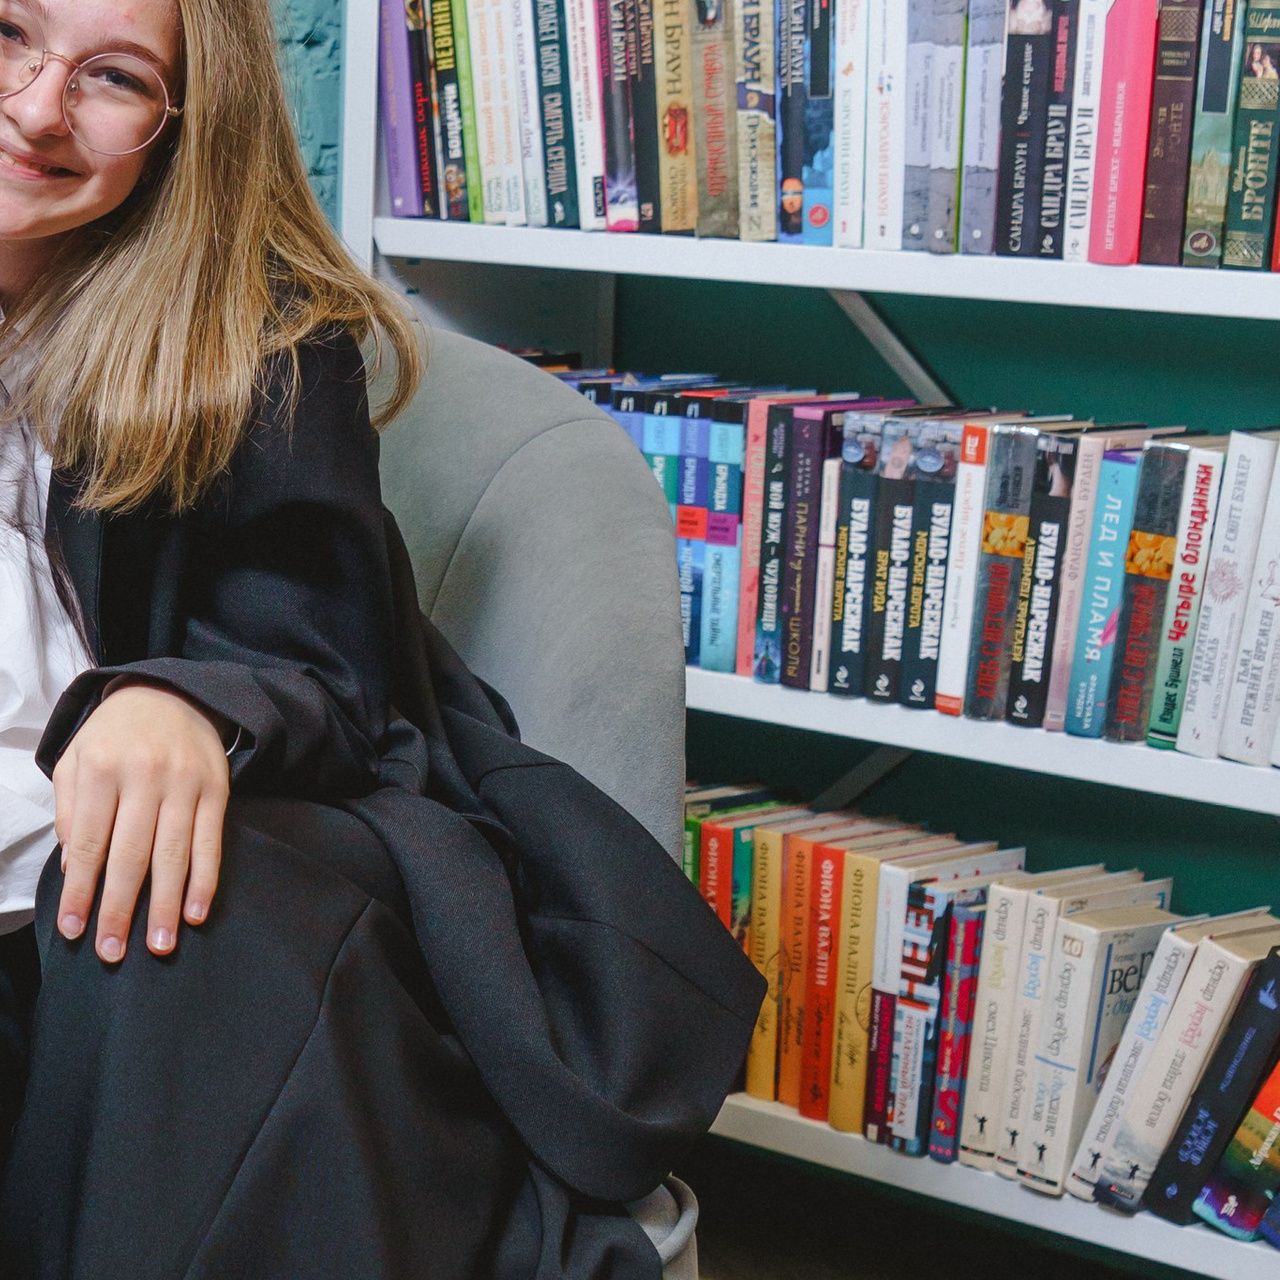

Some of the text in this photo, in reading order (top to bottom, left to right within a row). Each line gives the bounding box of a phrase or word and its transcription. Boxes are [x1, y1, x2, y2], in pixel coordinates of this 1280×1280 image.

[539, 43, 561, 87] БОУЭН
[611, 30, 628, 81] БРАУН
[638, 18, 654, 65] БРАУН
[664, 24, 684, 96] БРАУН
[742, 13, 763, 85] БРАУН
[791, 33, 806, 83] БРАУН
[443, 83, 463, 159] БОЛДАЧЧИ
[542, 92, 564, 146] СМЕРТЬ
[1043, 103, 1069, 160] БРАУН
[546, 146, 567, 196] СЕРДЦА
[1011, 142, 1028, 252] САНДРА БРАУН
[1039, 162, 1065, 228] САНДРА
[1070, 107, 1095, 230] САНДРА БРАУН
[1240, 120, 1274, 221] БРОНТЕ
[682, 457, 697, 505] БРЫНДЗА
[712, 464, 729, 511] БРЫНДЗА
[767, 480, 784, 509] МОЙ
[1073, 453, 1095, 502] БУРДЕН
[765, 512, 782, 544] МУЖ
[1066, 509, 1089, 582] ФРАНСУАЗА
[1181, 463, 1214, 565] блондинки
[760, 558, 779, 632] ЧУДОВИЩЕ
[786, 501, 810, 678] ПАРНИ ШКОЛЫ
[832, 525, 849, 621] МОРСКИЕ ВОРОТА
[873, 550, 889, 612] БРАТ ИУДА
[907, 530, 928, 628] МОРСКИЕ ВОРОТА
[982, 562, 1011, 642] ВЕТЧИНОЙ
[1084, 494, 1122, 662] ЛЕД И ПЛАМЯ
[1010, 599, 1030, 662] ЗРИТЕЛЕЙ
[1167, 572, 1198, 642] Четыре
[976, 658, 1001, 701] ХЛЕБ
[1116, 584, 1156, 724] ХЛЕБ С ВЕТЧИНОЙ
[1165, 648, 1184, 689] Бушнелл
[1201, 637, 1221, 686] МЫСЛЬ
[1236, 649, 1252, 684] ТЬМА
[1240, 609, 1275, 727] ПРЕЖНИХ ВРЕМЕН
[756, 841, 771, 893] ФИОНА
[793, 850, 806, 909] ФИОНА
[817, 858, 834, 922] ФИОНА
[844, 868, 864, 995] ФИОНА ВАЛПИ
